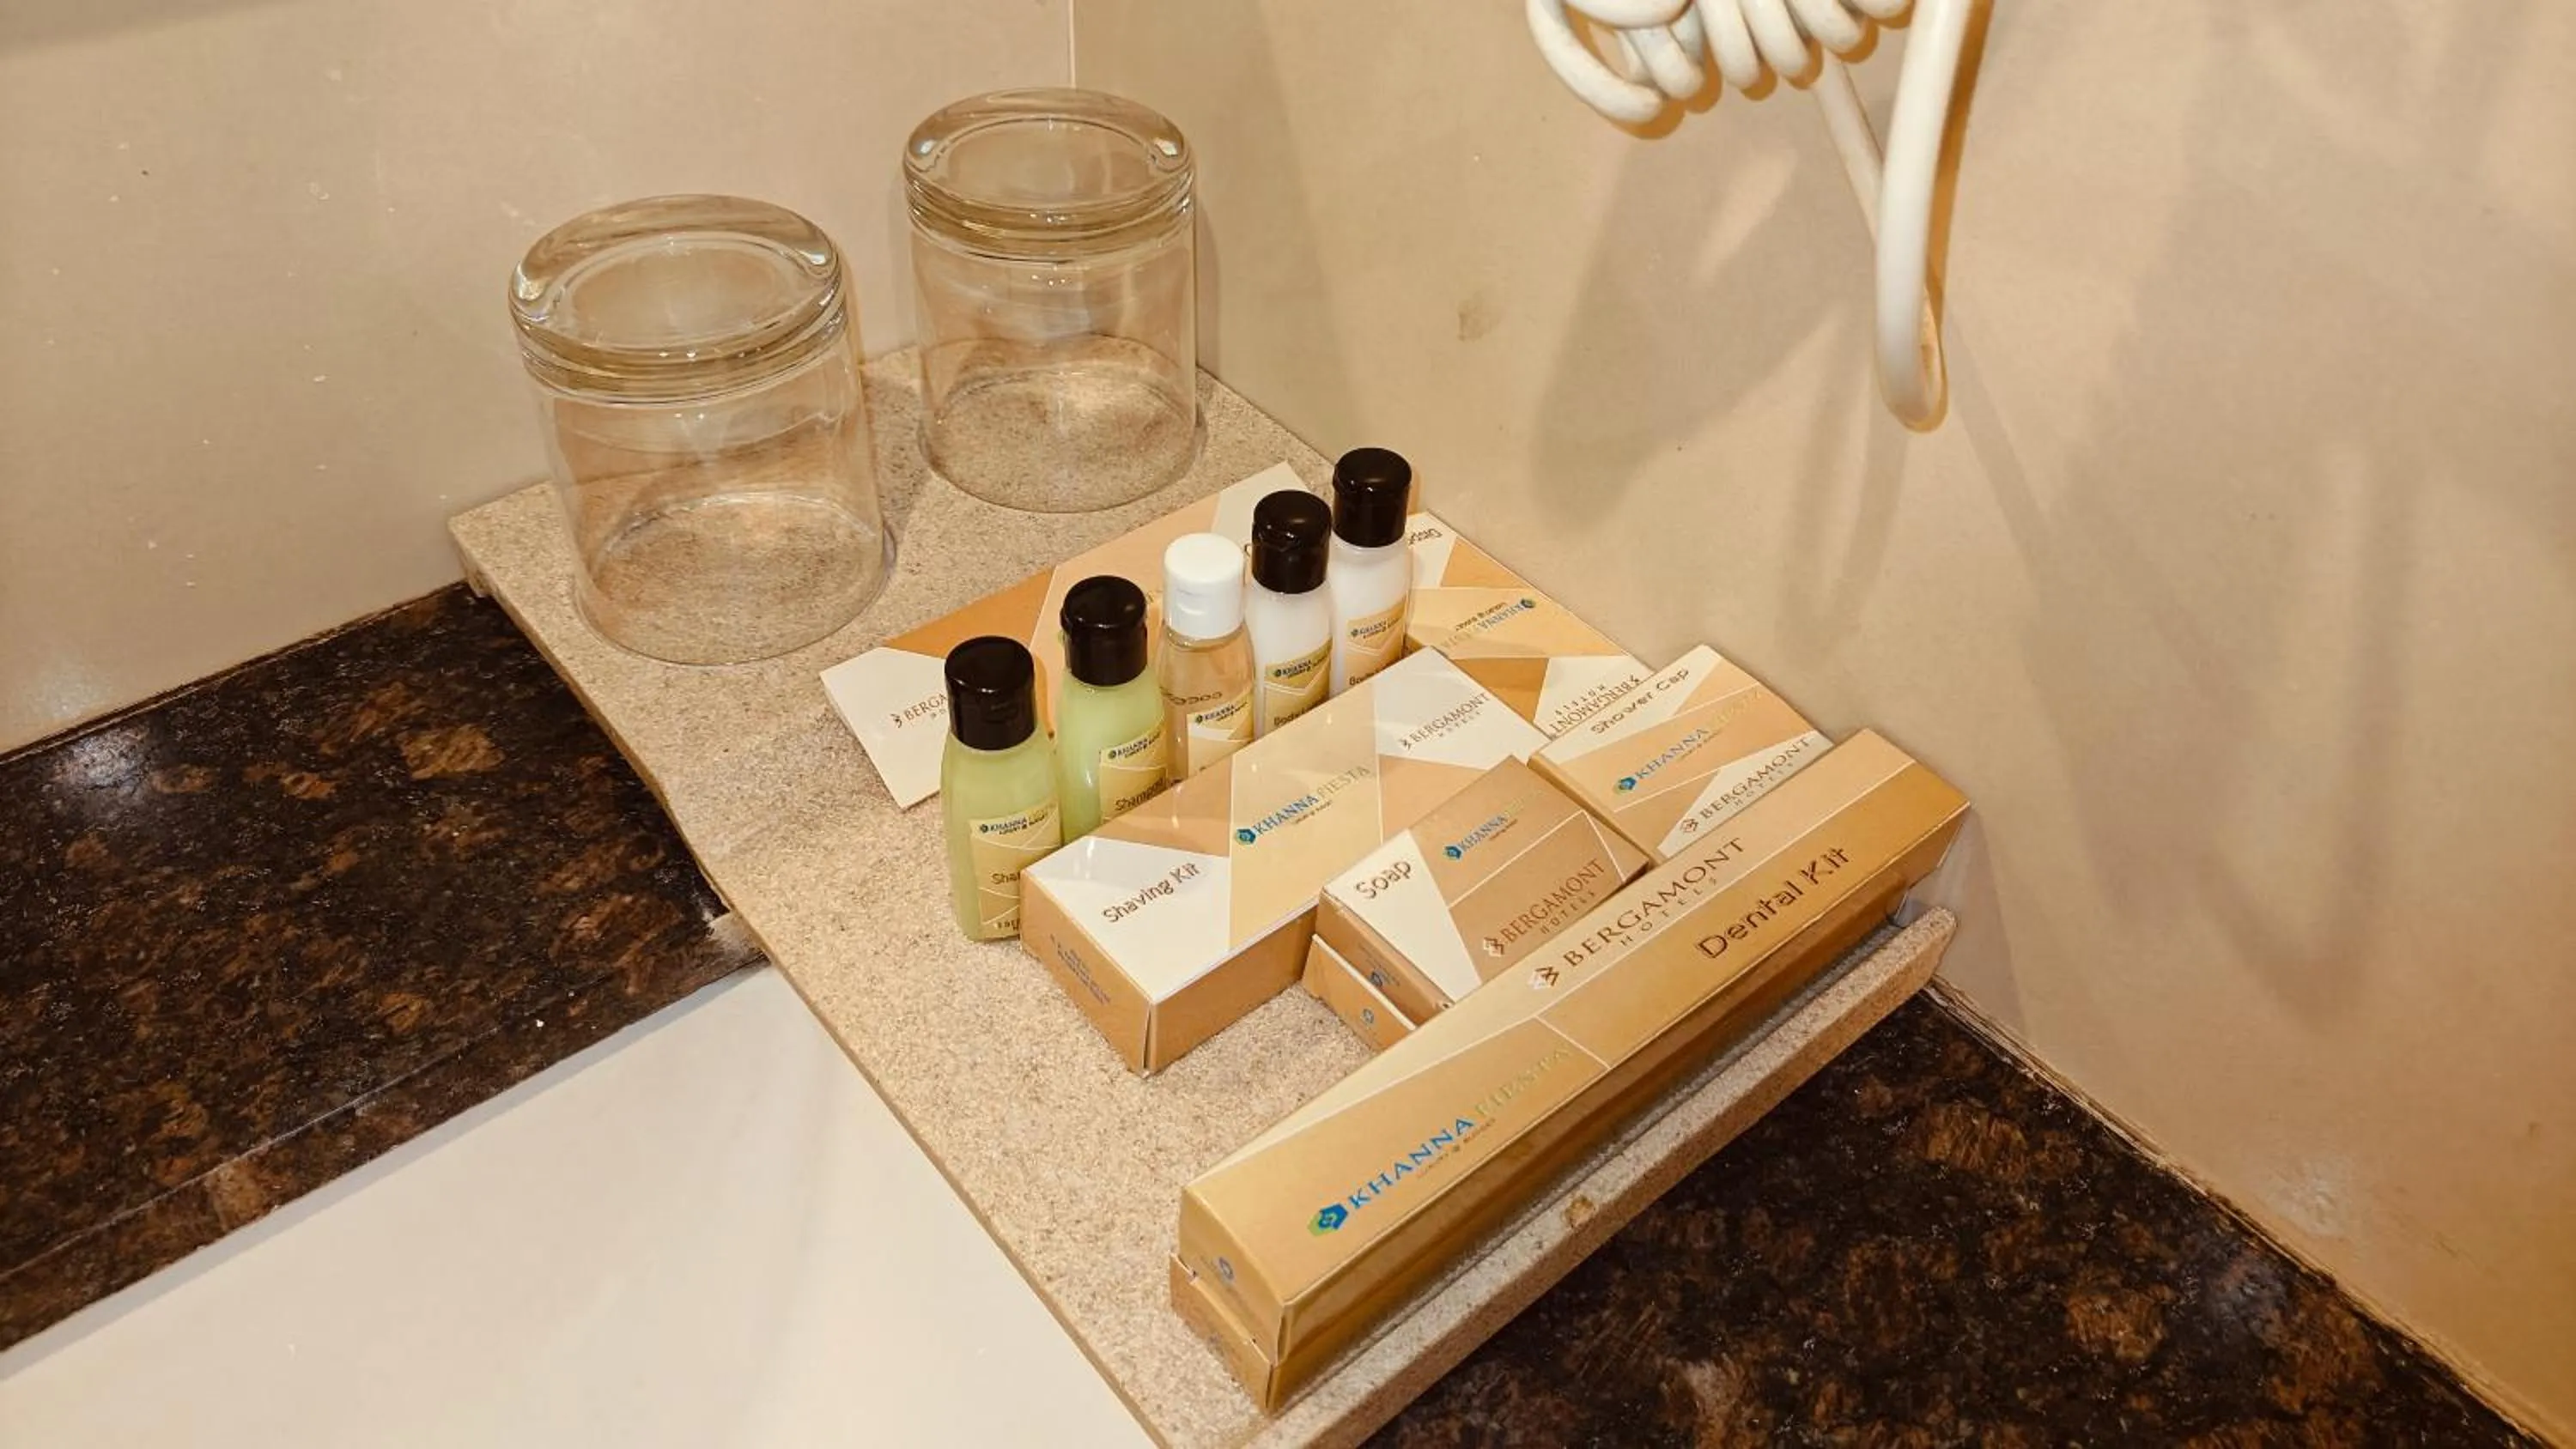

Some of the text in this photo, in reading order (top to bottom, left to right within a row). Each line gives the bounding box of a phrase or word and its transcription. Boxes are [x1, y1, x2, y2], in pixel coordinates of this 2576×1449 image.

[903, 693, 948, 721] BERGA
[1409, 692, 1491, 742] BERGAMONT
[1591, 667, 1689, 734] Shower Cap
[1636, 728, 1710, 779] KHANNA
[1699, 737, 1812, 820] BERGAMONT
[1253, 794, 1319, 835] KHANNA
[1316, 766, 1370, 799] FIESTA
[991, 870, 1020, 885] Sha
[1103, 862, 1200, 923] Shaving Kit
[1356, 859, 1413, 900] Soap
[1499, 858, 1607, 944] BERGAMONT
[1562, 837, 1747, 968] BERGAMONT
[1697, 846, 1850, 960] Dental Kit
[1619, 876, 1718, 948] HOTELS
[1347, 1116, 1475, 1210] KHANNA
